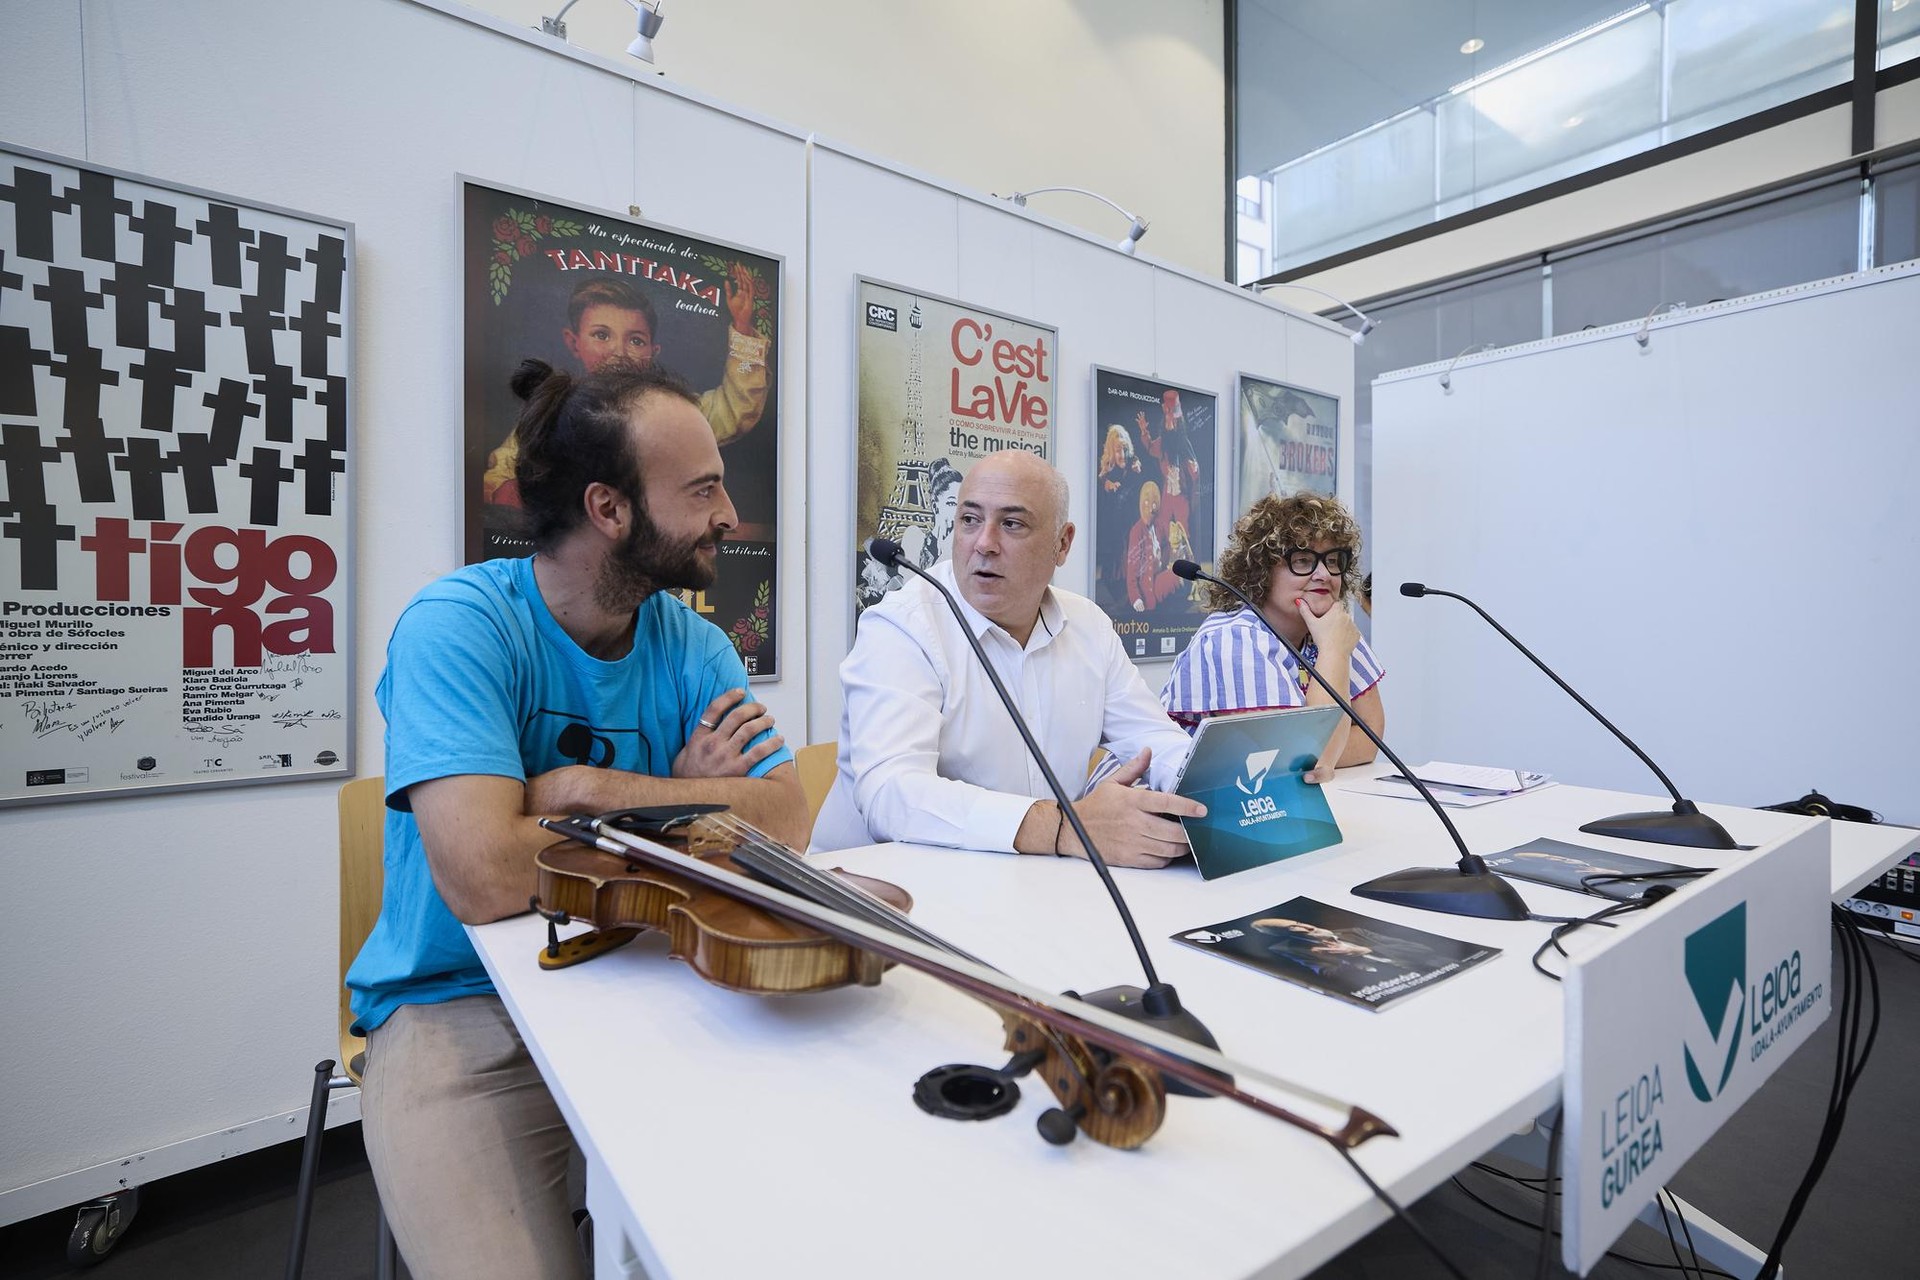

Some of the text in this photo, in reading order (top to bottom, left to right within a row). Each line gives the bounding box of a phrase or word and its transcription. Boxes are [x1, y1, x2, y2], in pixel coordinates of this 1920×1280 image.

[587, 223, 699, 260] Un espectáculo de:
[546, 249, 721, 307] TANTTAKA
[868, 305, 895, 321] CRC
[949, 427, 978, 450] the
[1279, 441, 1334, 477] BROKERS
[3, 602, 171, 617] Producciones
[45, 620, 93, 629] Murillo
[1113, 618, 1150, 634] inotxo
[8, 629, 125, 638] obra de Sófocles
[42, 644, 51, 652] y
[55, 641, 118, 651] dirección
[31, 663, 68, 672] Acedo
[182, 669, 216, 677] Miguel
[219, 668, 234, 676] del
[34, 672, 78, 680] Llorens
[14, 680, 44, 689] Iñaki
[47, 680, 98, 688] Salvador
[16, 689, 65, 697] Pimenta
[128, 686, 168, 694] Sueiras
[221, 691, 254, 699] Melgar
[182, 713, 261, 723] Kandido Uranga
[1601, 1063, 1664, 1161] LEIOA
[1602, 1119, 1663, 1209] GUREA
